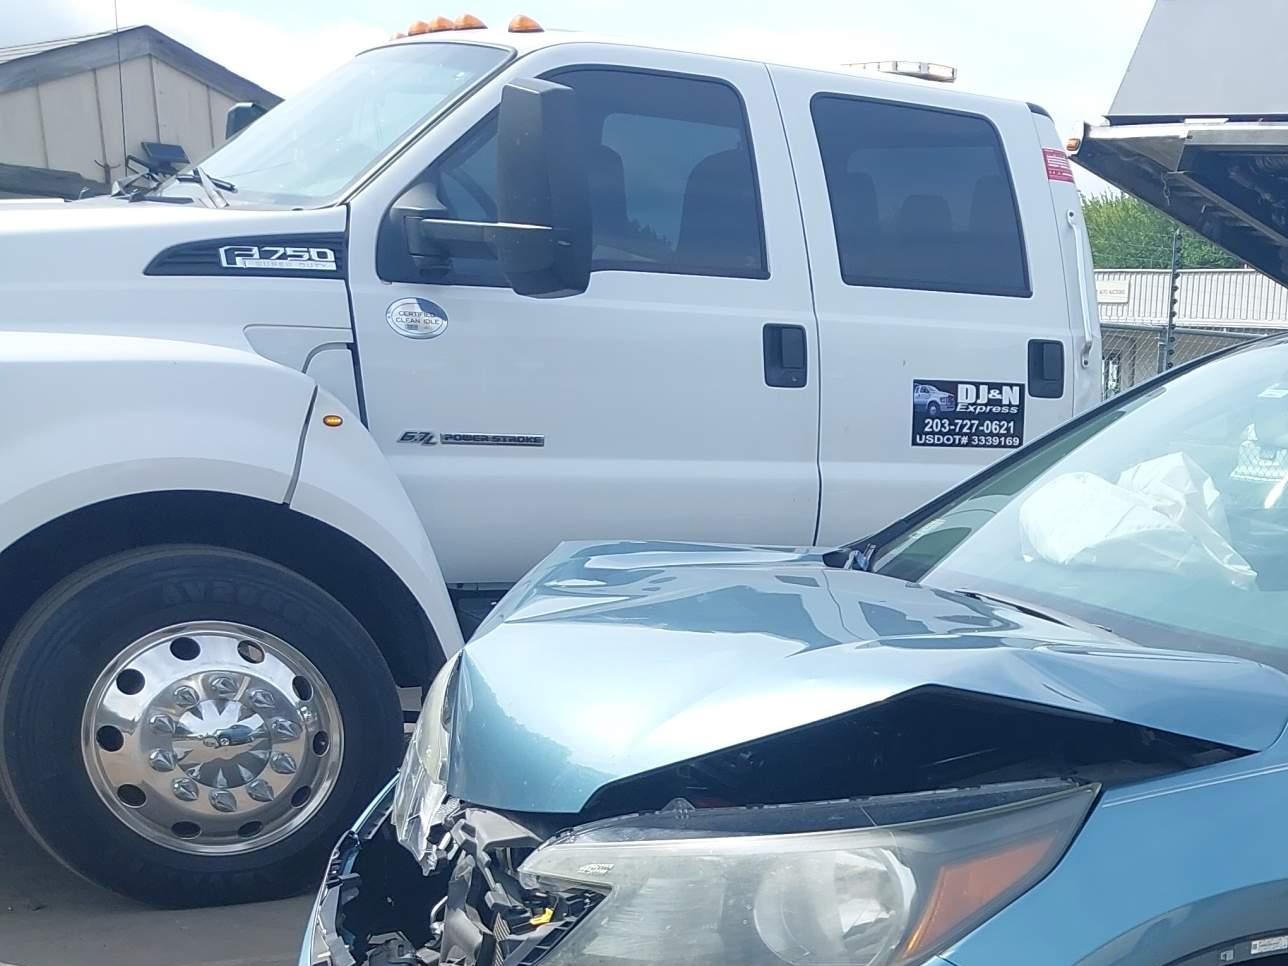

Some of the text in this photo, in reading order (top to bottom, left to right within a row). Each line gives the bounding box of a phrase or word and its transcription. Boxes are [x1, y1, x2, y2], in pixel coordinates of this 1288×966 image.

[957, 383, 1020, 405] DJ&N
[956, 403, 1019, 414] Express
[924, 419, 1015, 434] 203-727-0621
[444, 433, 489, 442] POWER
[491, 435, 545, 444] STROKE
[916, 434, 1020, 446] USDOT# 3339169
